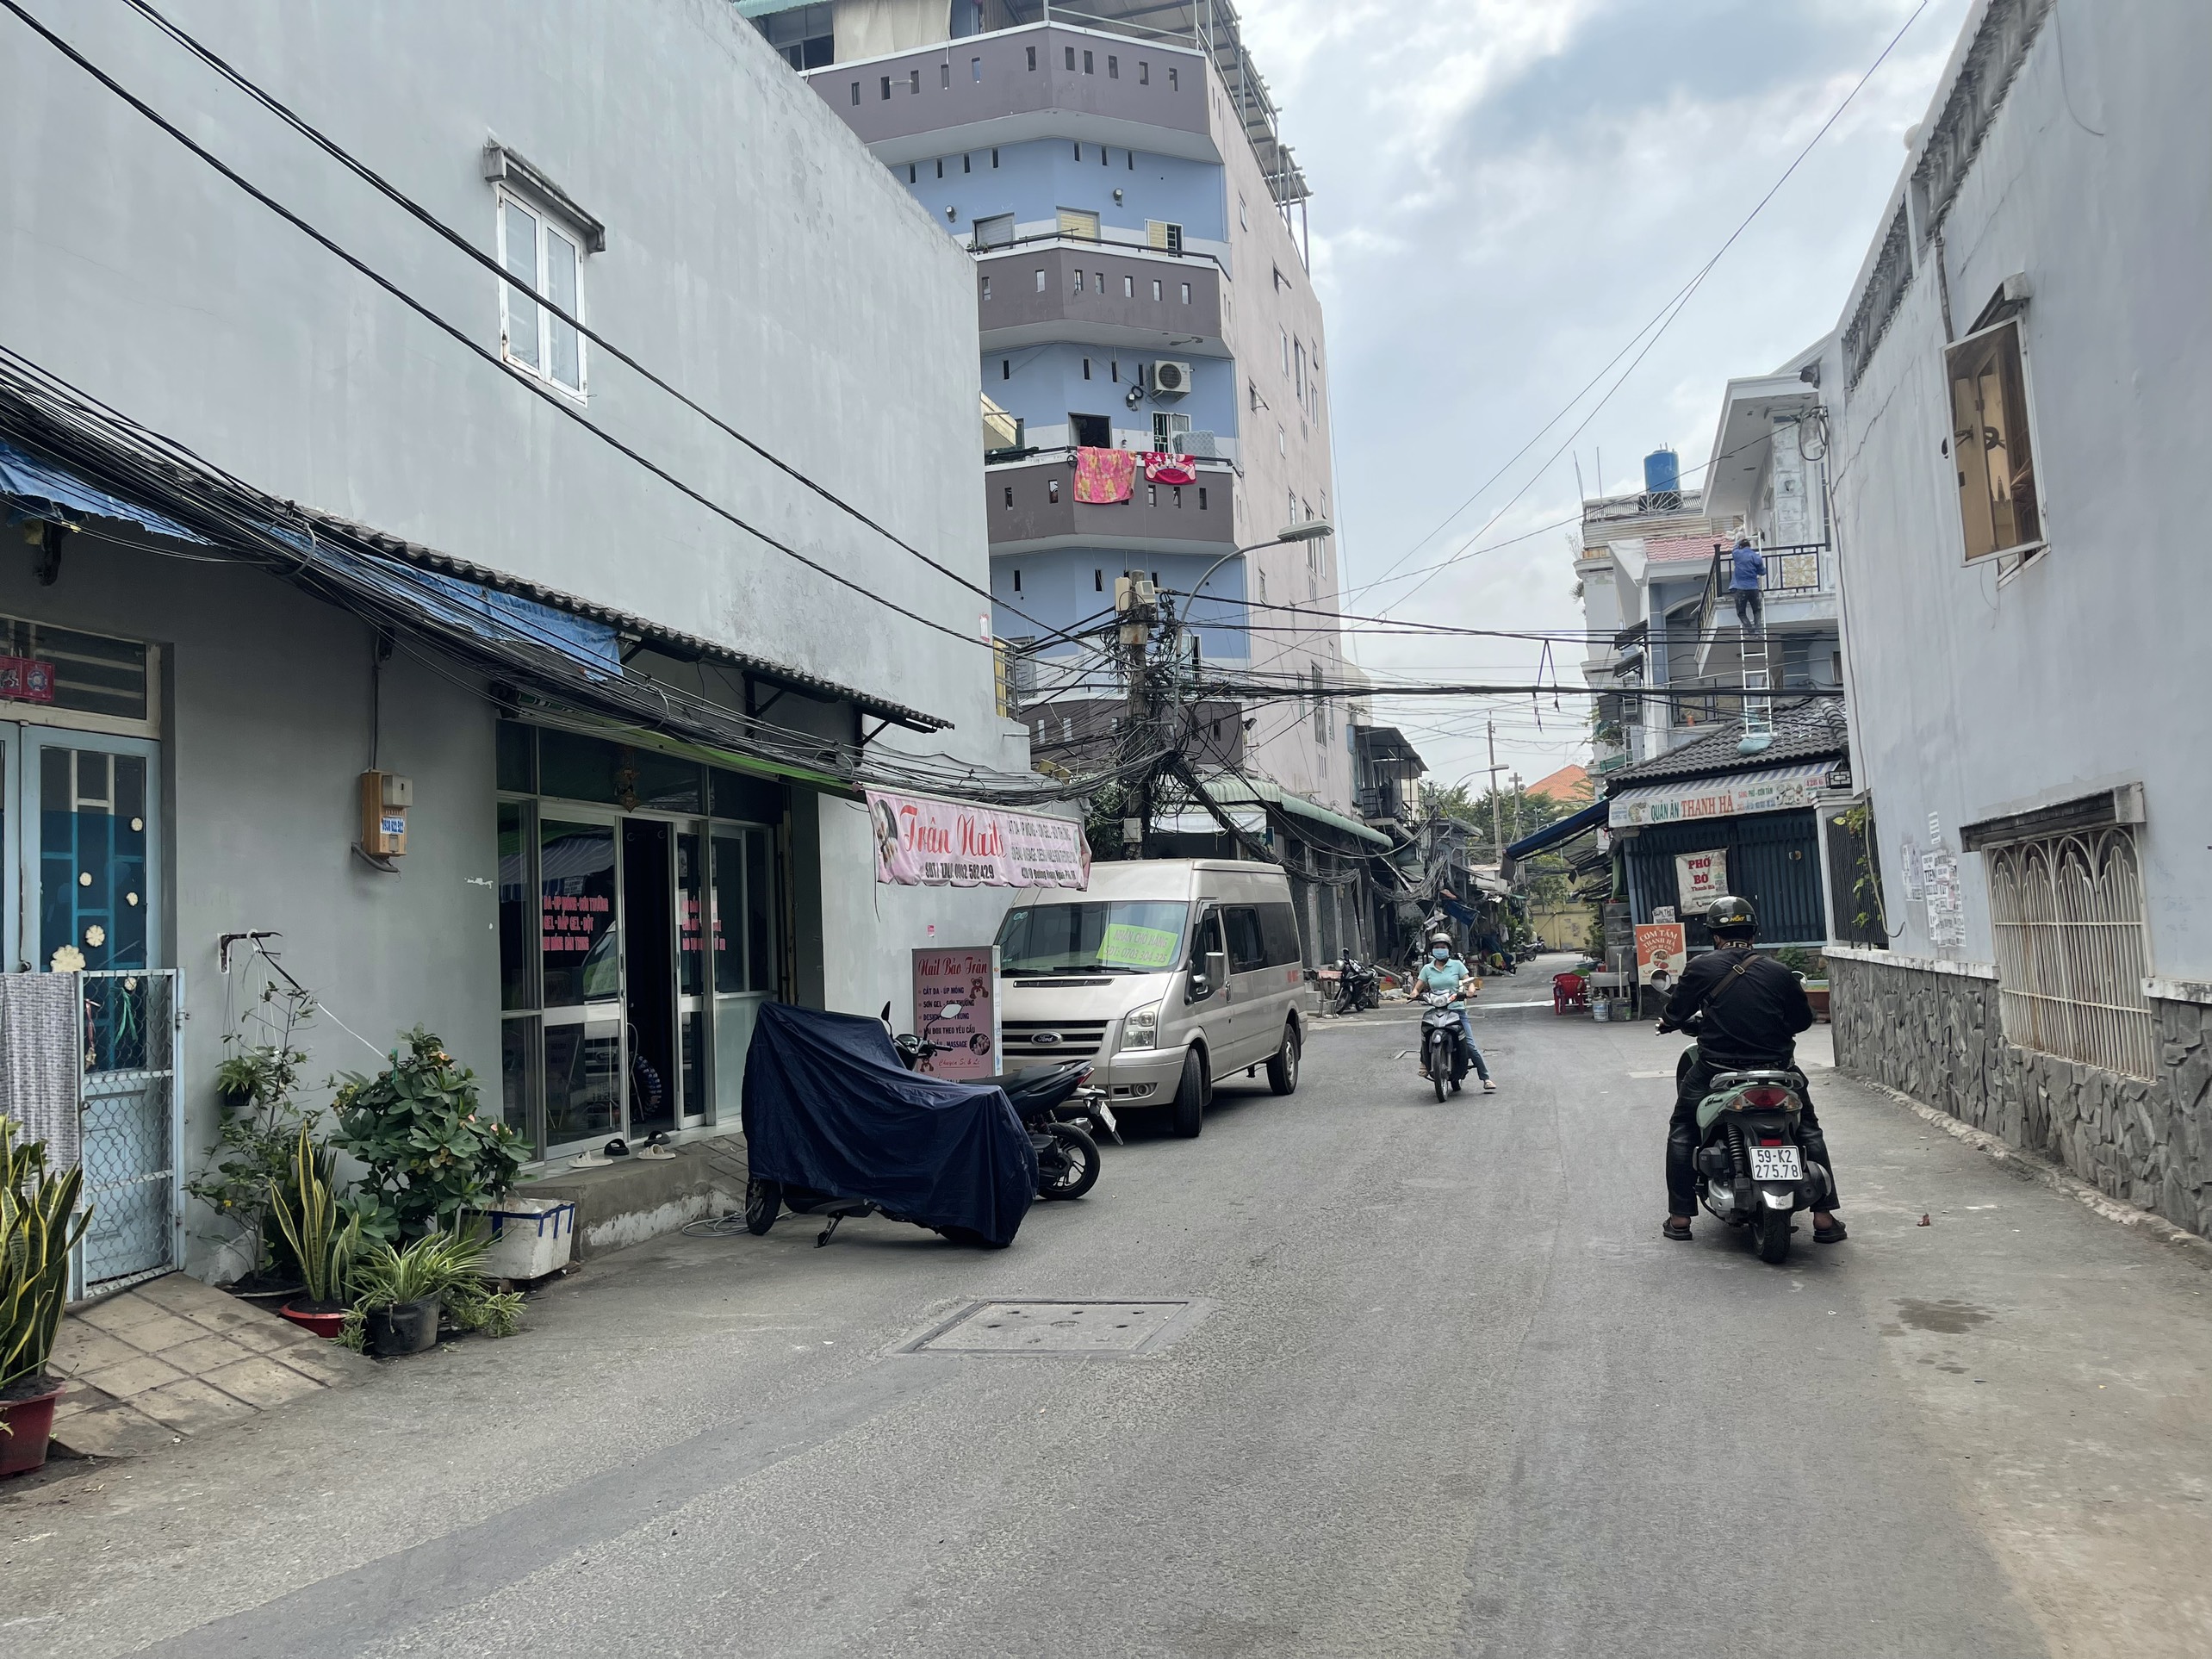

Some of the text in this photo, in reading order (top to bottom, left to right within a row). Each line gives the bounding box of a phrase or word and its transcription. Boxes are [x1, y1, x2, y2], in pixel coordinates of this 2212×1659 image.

[1651, 799, 1668, 823] QUÁN
[1681, 797, 1716, 817] THANH
[1718, 789, 1734, 813] HÀ
[900, 805, 953, 854] Trân
[1688, 855, 1711, 869] PHỞ
[1693, 872, 1709, 884] BÒ
[918, 956, 987, 976] Nail Bảo Trân
[1757, 1150, 1793, 1163] 59-K2
[1755, 1165, 1798, 1178] 275.78
